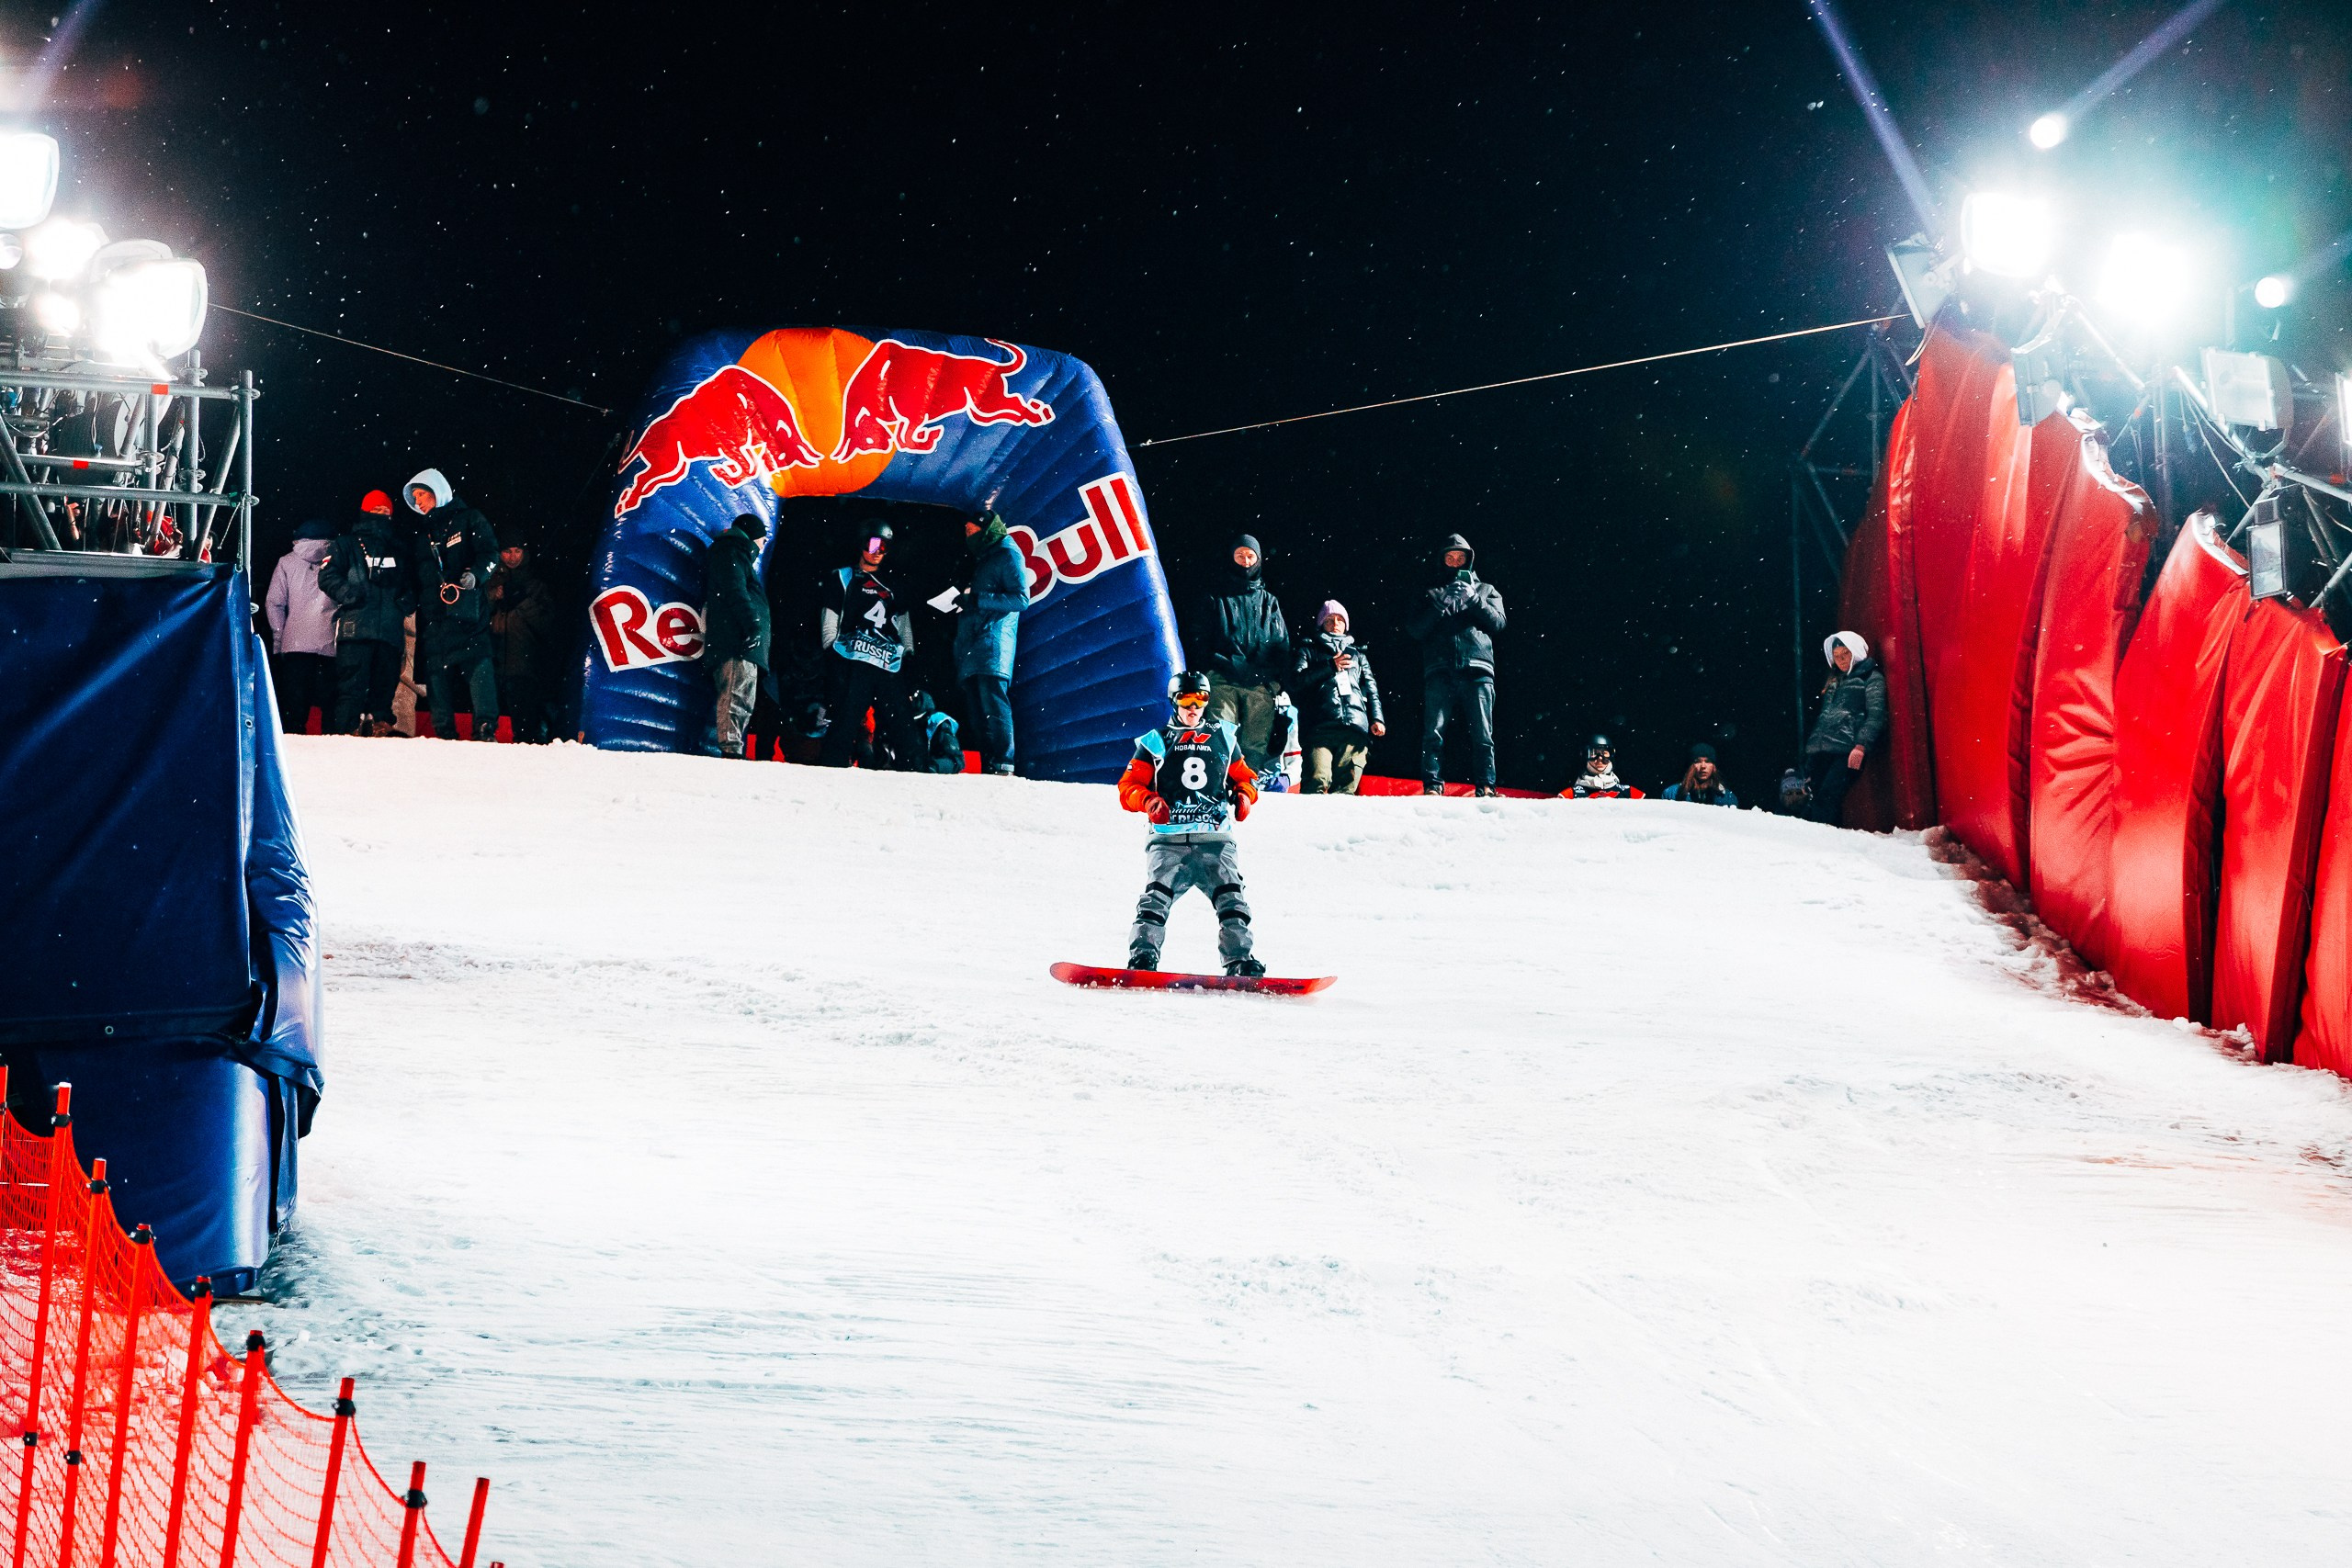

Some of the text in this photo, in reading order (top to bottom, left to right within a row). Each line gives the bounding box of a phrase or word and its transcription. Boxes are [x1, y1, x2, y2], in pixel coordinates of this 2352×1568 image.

[591, 475, 1151, 669] Re Bull
[864, 600, 888, 629] 4
[854, 640, 892, 663] RUSSIE
[1181, 757, 1208, 790] 8
